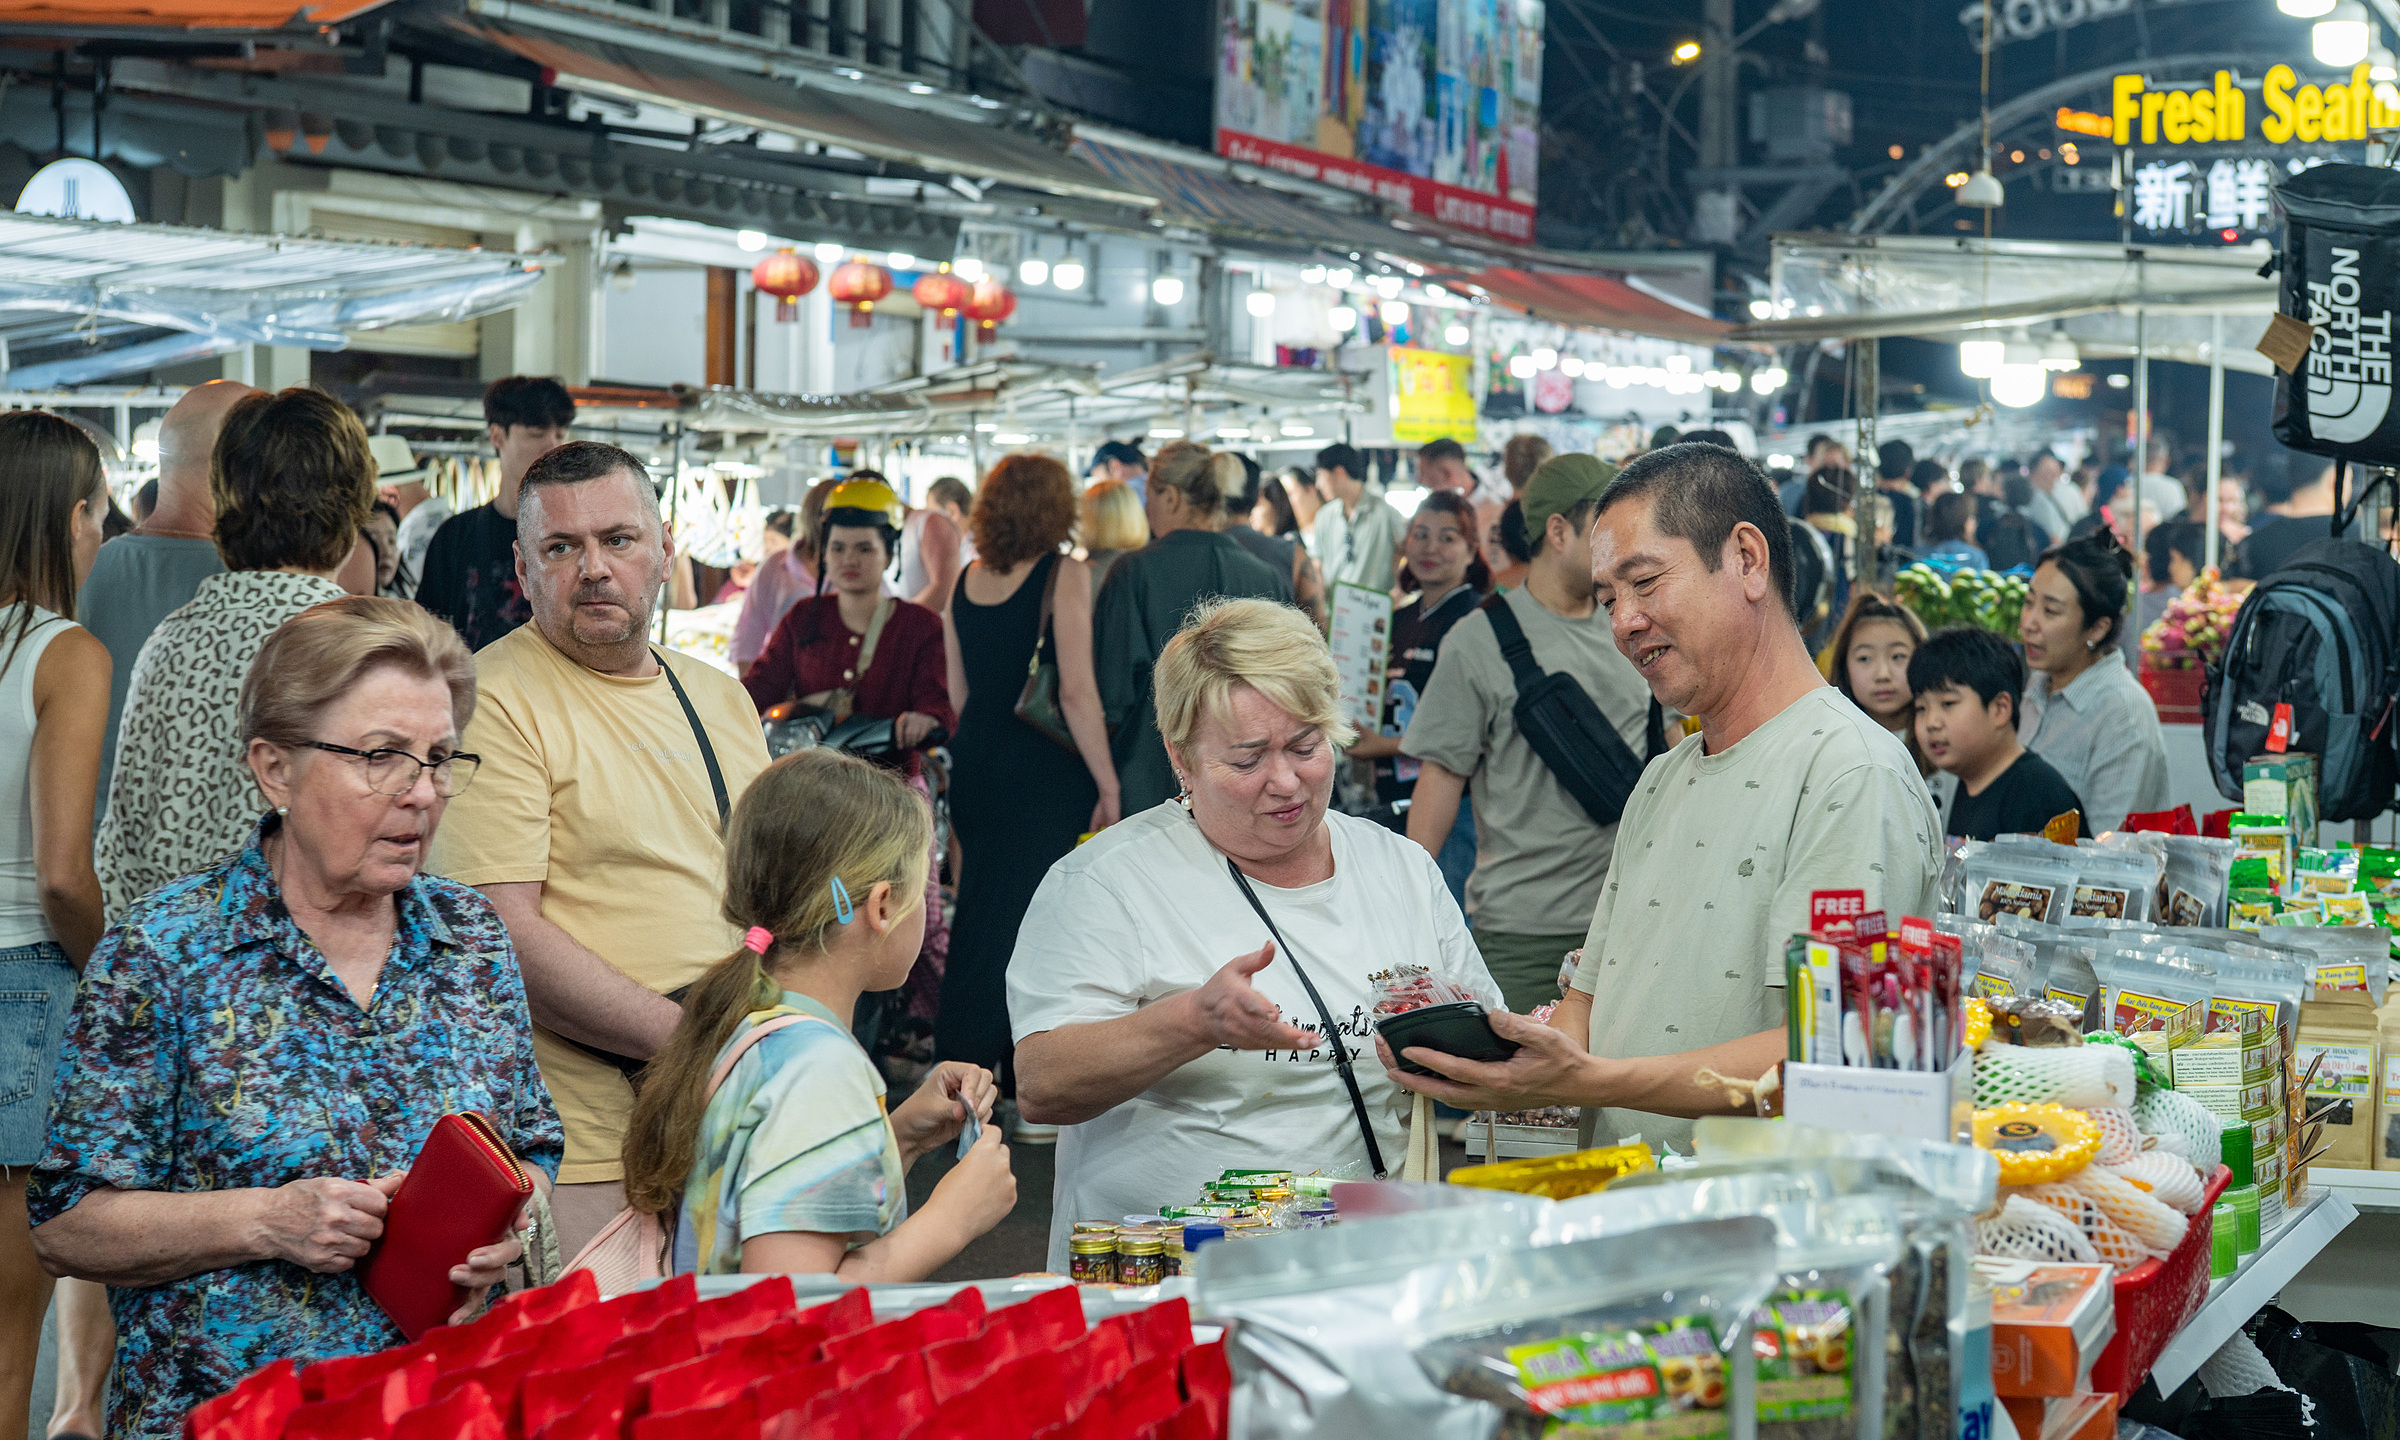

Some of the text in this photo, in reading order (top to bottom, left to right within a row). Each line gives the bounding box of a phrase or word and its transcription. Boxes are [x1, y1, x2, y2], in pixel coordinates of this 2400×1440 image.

[2113, 71, 2246, 145] Fresh
[2307, 280, 2333, 378] FACE
[2330, 247, 2360, 382] NORTH
[2360, 310, 2392, 384] THE
[1814, 896, 1863, 916] FREE
[1901, 924, 1932, 948] FREE
[1265, 1048, 1361, 1062] HAPPY
[2352, 1062, 2368, 1073] Long
